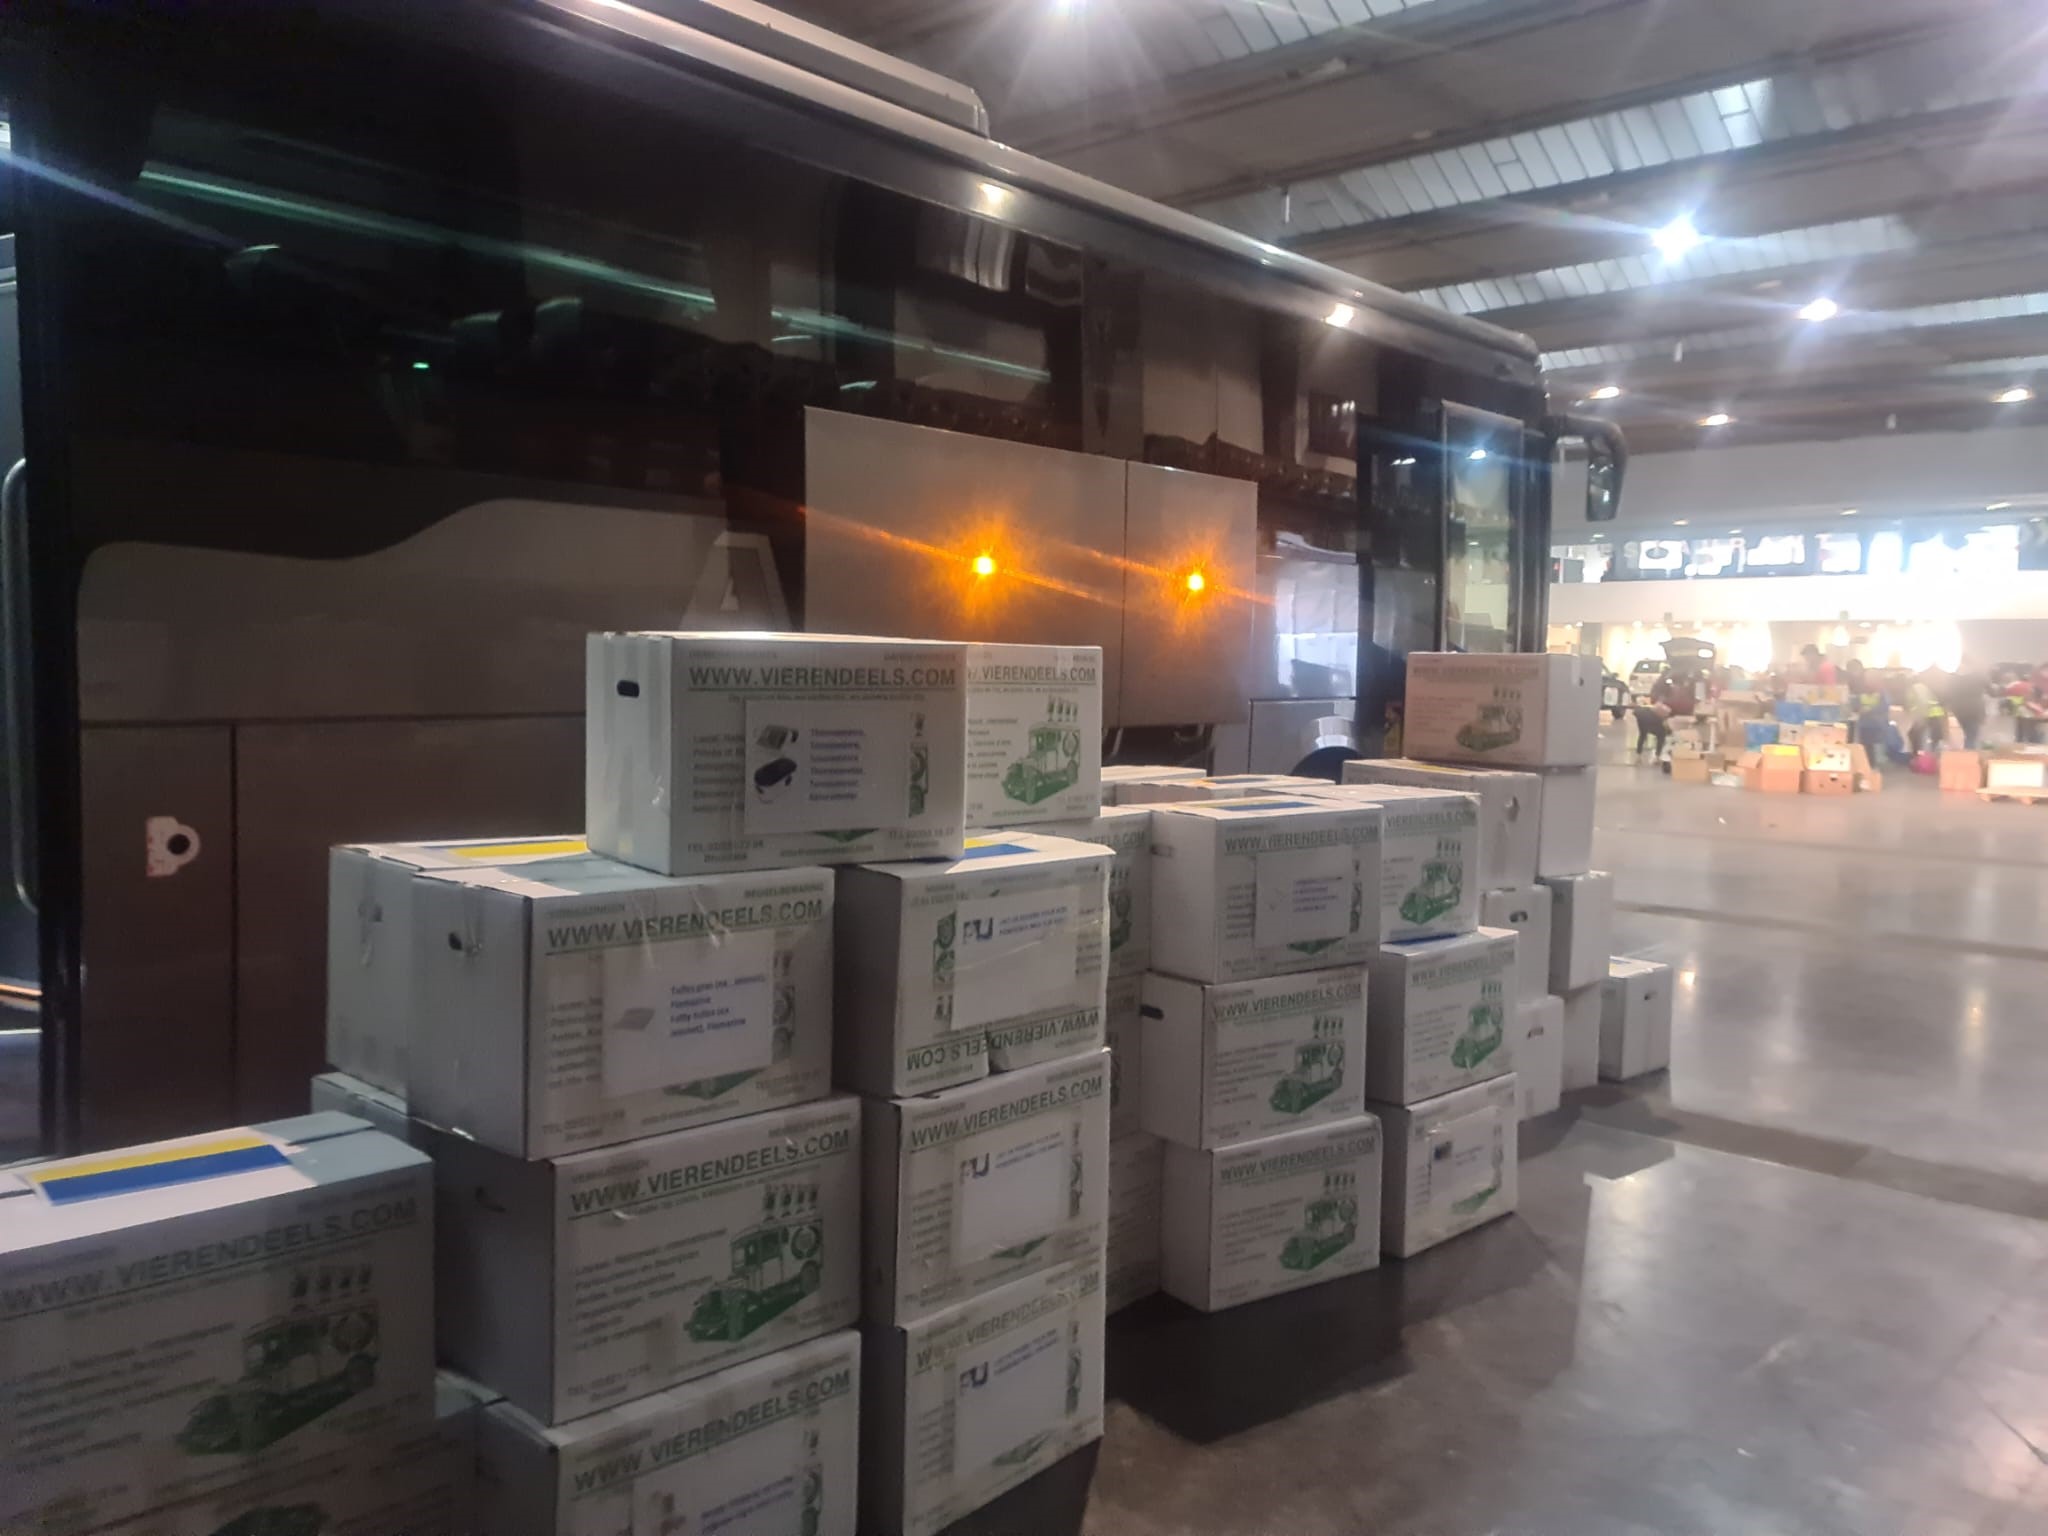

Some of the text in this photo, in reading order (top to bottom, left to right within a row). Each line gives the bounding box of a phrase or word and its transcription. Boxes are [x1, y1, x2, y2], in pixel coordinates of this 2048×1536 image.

[688, 667, 956, 687] WWW.VIERENDEELS.COM
[546, 899, 823, 949] WWW.VIERENDEELS.COM
[1212, 983, 1362, 1019] WWW.VIERENDEELS.COM
[911, 1075, 1103, 1148] WWW.VIERENDEELS.COM
[571, 1130, 849, 1213] WWW.VIERENDEELS.COM
[1219, 1135, 1375, 1181] WWW.VIERENDEELS.COM
[0, 1196, 418, 1312] WWW.VIERENDEELS.COM
[573, 1367, 850, 1492] WWW.VIERENDEELS.COM
